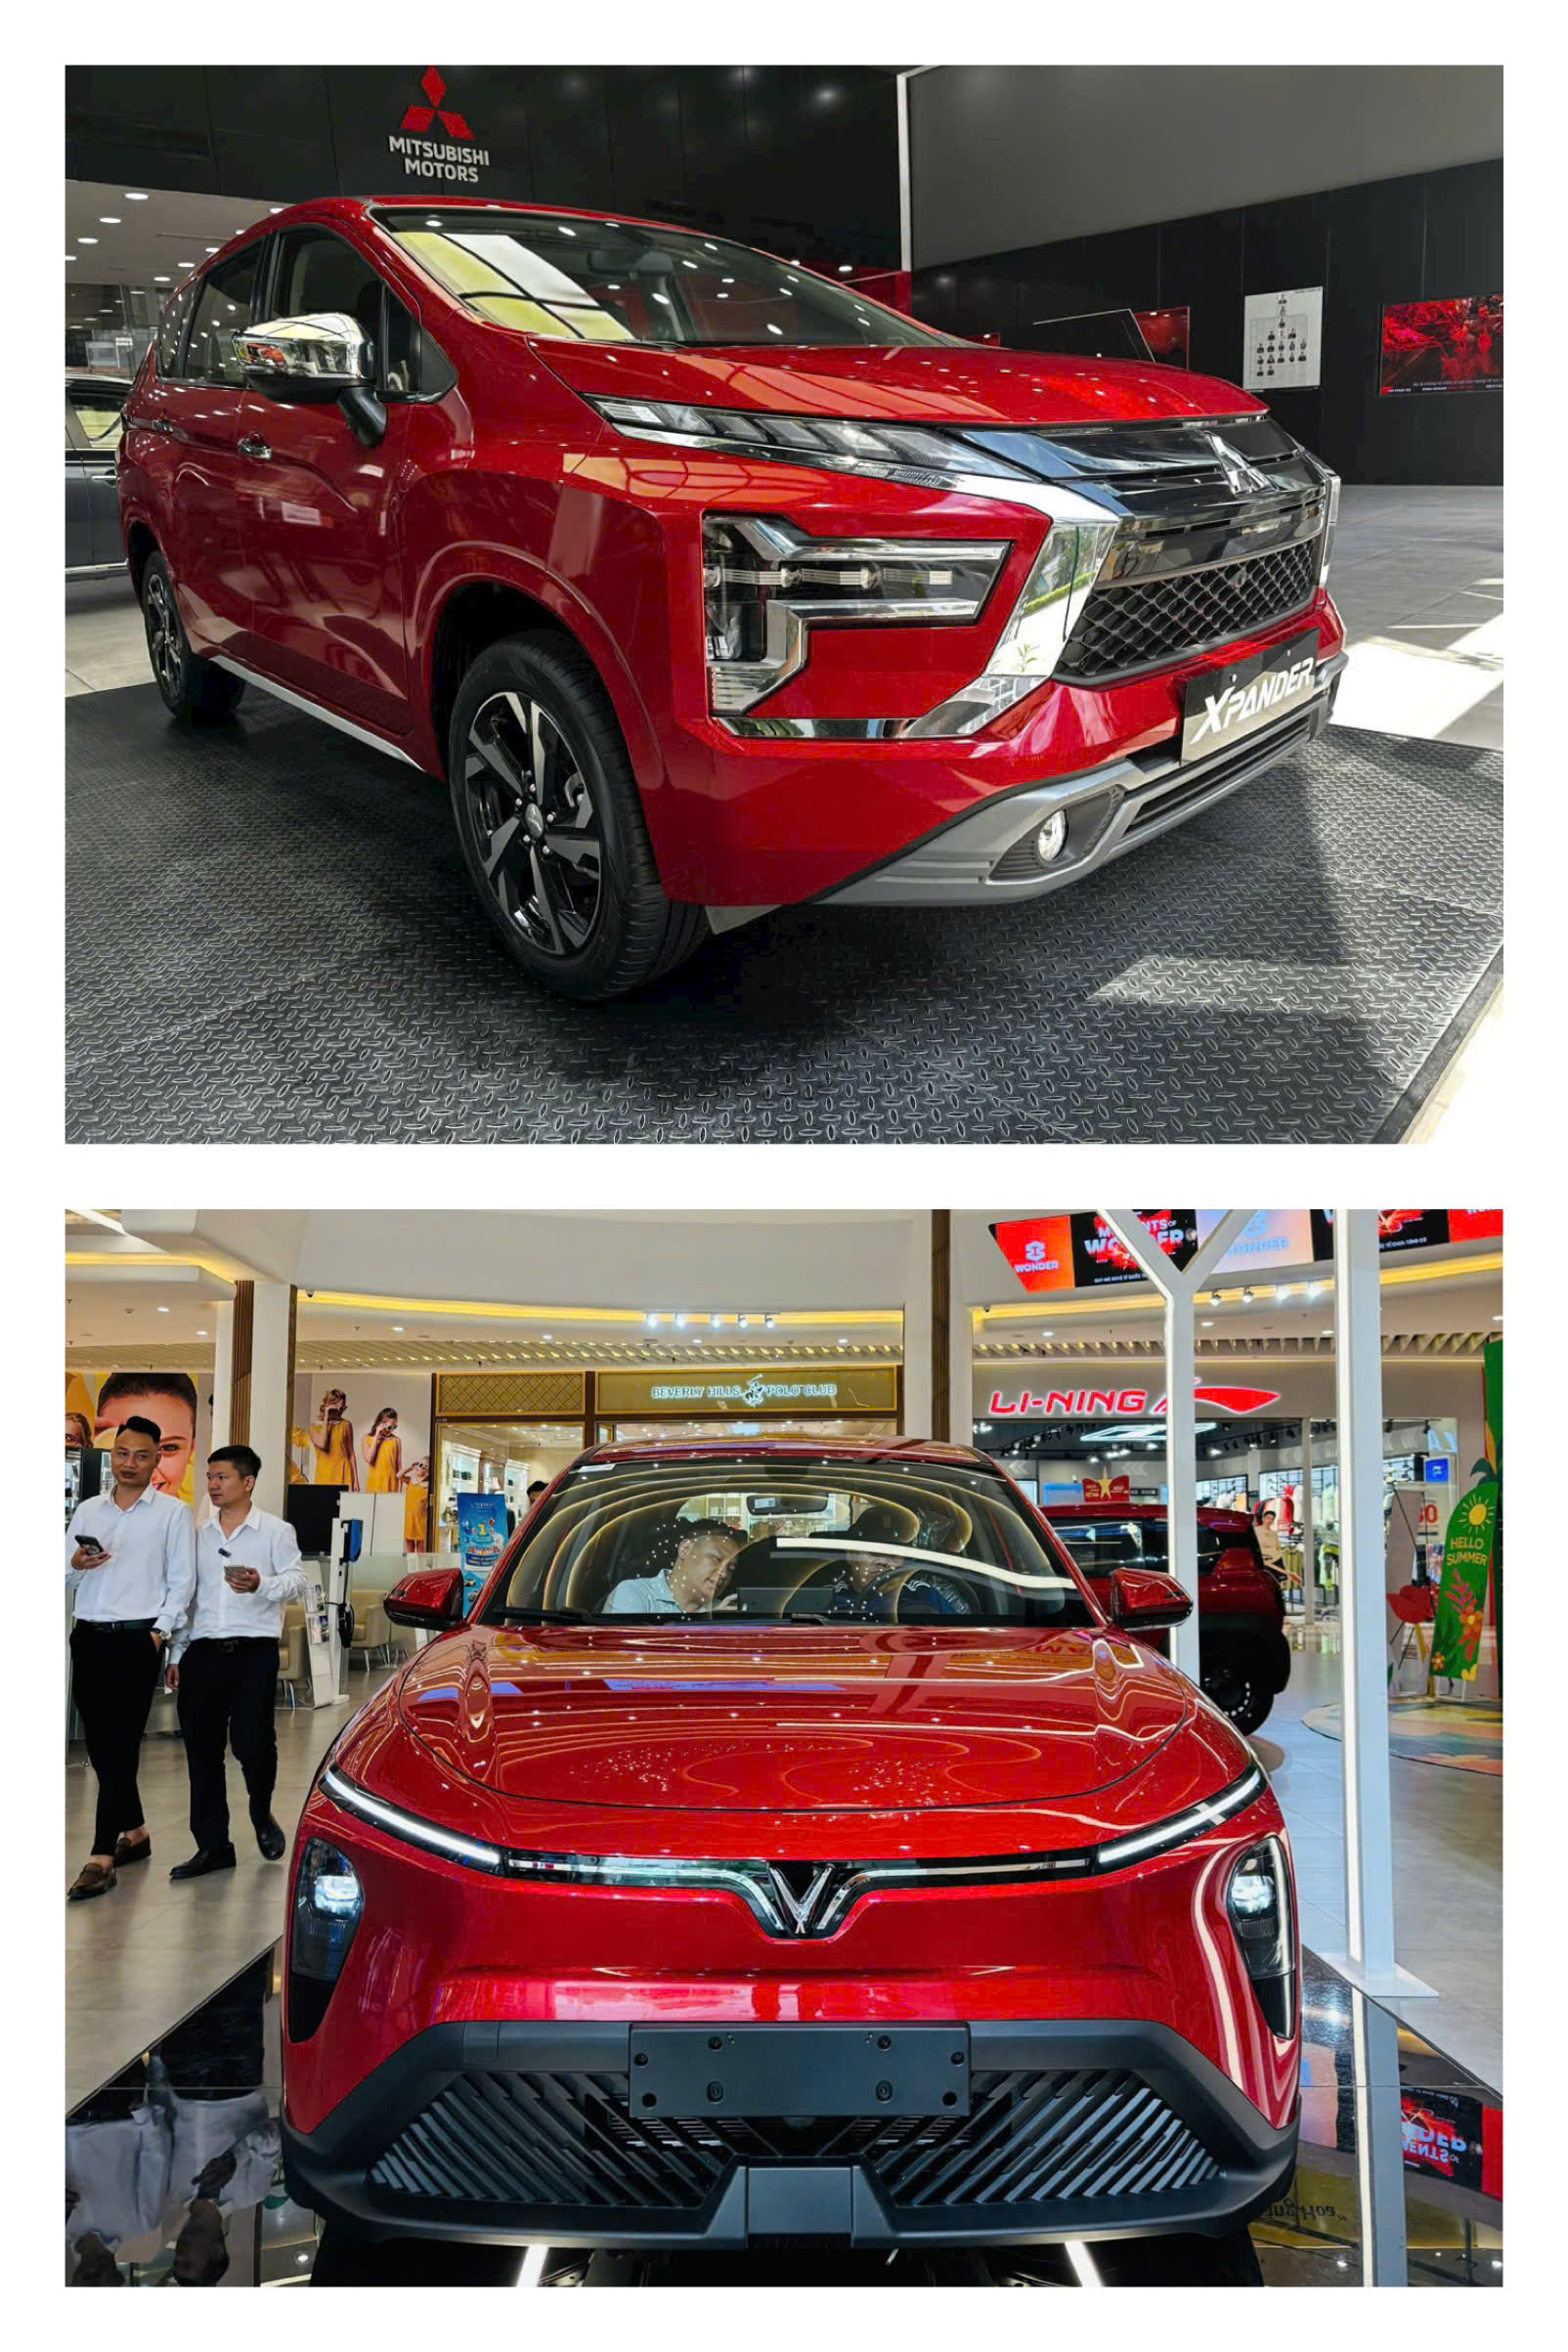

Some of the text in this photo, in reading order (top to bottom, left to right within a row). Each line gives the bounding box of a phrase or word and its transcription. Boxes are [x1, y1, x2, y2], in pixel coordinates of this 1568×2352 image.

[388, 135, 490, 166] MITSUBISHI
[404, 157, 479, 183] MOTORS
[1189, 656, 1315, 746] XPANDER
[1015, 1258, 1059, 1273] WONDER
[652, 1383, 837, 1399] BEVERLY HILLS POLO CLUB
[988, 1389, 1147, 1415] LI-NING
[1450, 1537, 1484, 1550] HELLO
[1447, 1551, 1487, 1566] SUMMER
